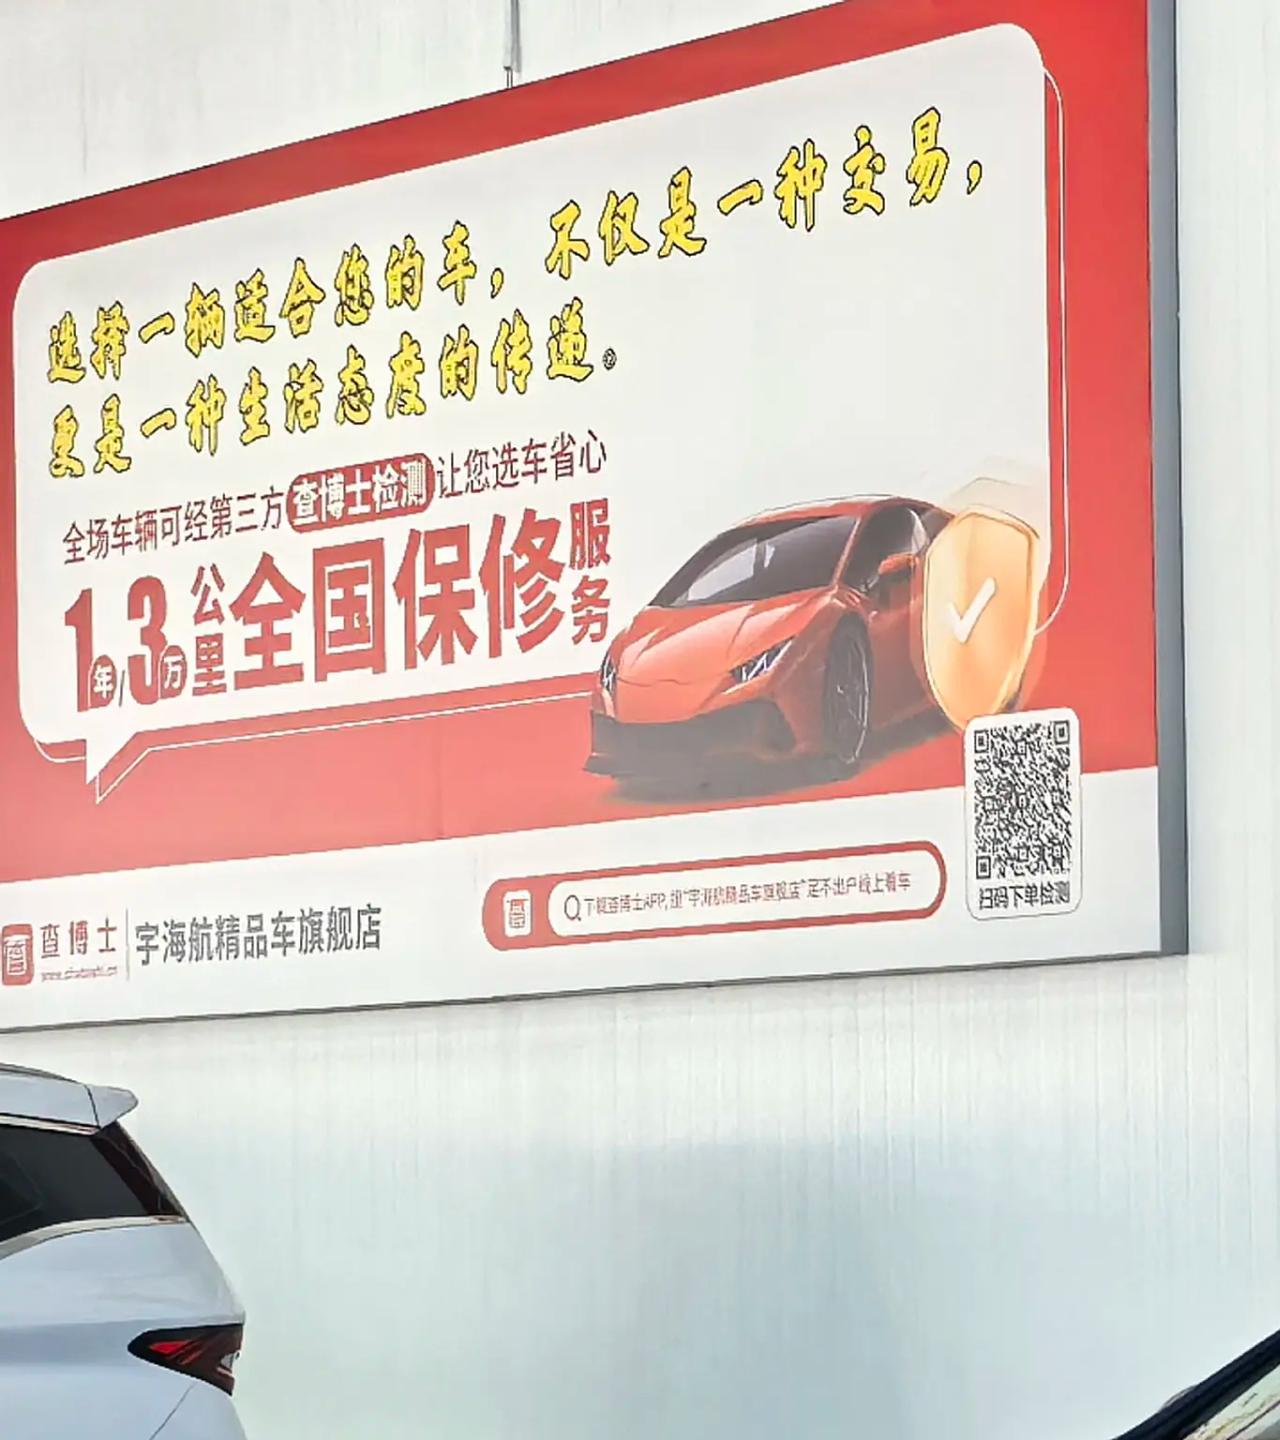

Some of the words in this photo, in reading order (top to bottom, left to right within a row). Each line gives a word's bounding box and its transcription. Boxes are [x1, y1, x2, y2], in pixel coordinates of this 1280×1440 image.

[40, 915, 118, 959] 查博士
[135, 903, 382, 966] 宇海航精品车旗舰店
